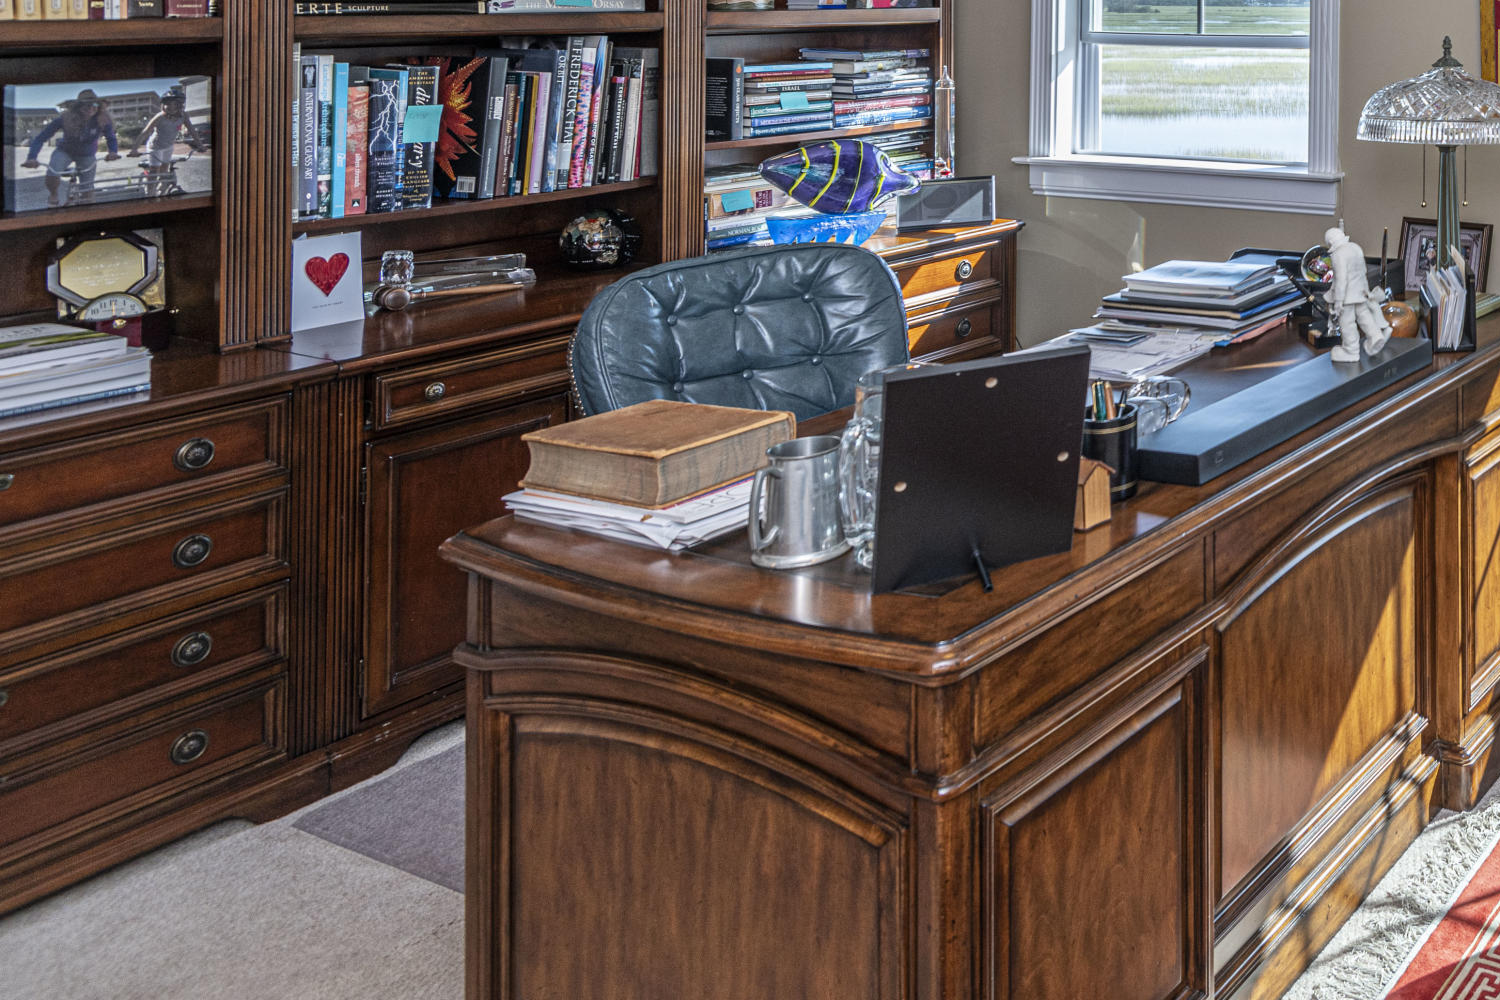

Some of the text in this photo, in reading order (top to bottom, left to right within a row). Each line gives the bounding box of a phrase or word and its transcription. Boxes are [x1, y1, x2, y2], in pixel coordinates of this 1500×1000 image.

[296, 3, 342, 14] ERTE
[556, 55, 567, 84] ORBIT
[566, 47, 583, 117] FREDERICK
[305, 92, 313, 145] INTERNATIONAL
[321, 101, 329, 147] Architecture
[615, 86, 623, 130] CONTEMPORARY
[304, 168, 312, 180] ART
[728, 227, 751, 236] NORMAN
